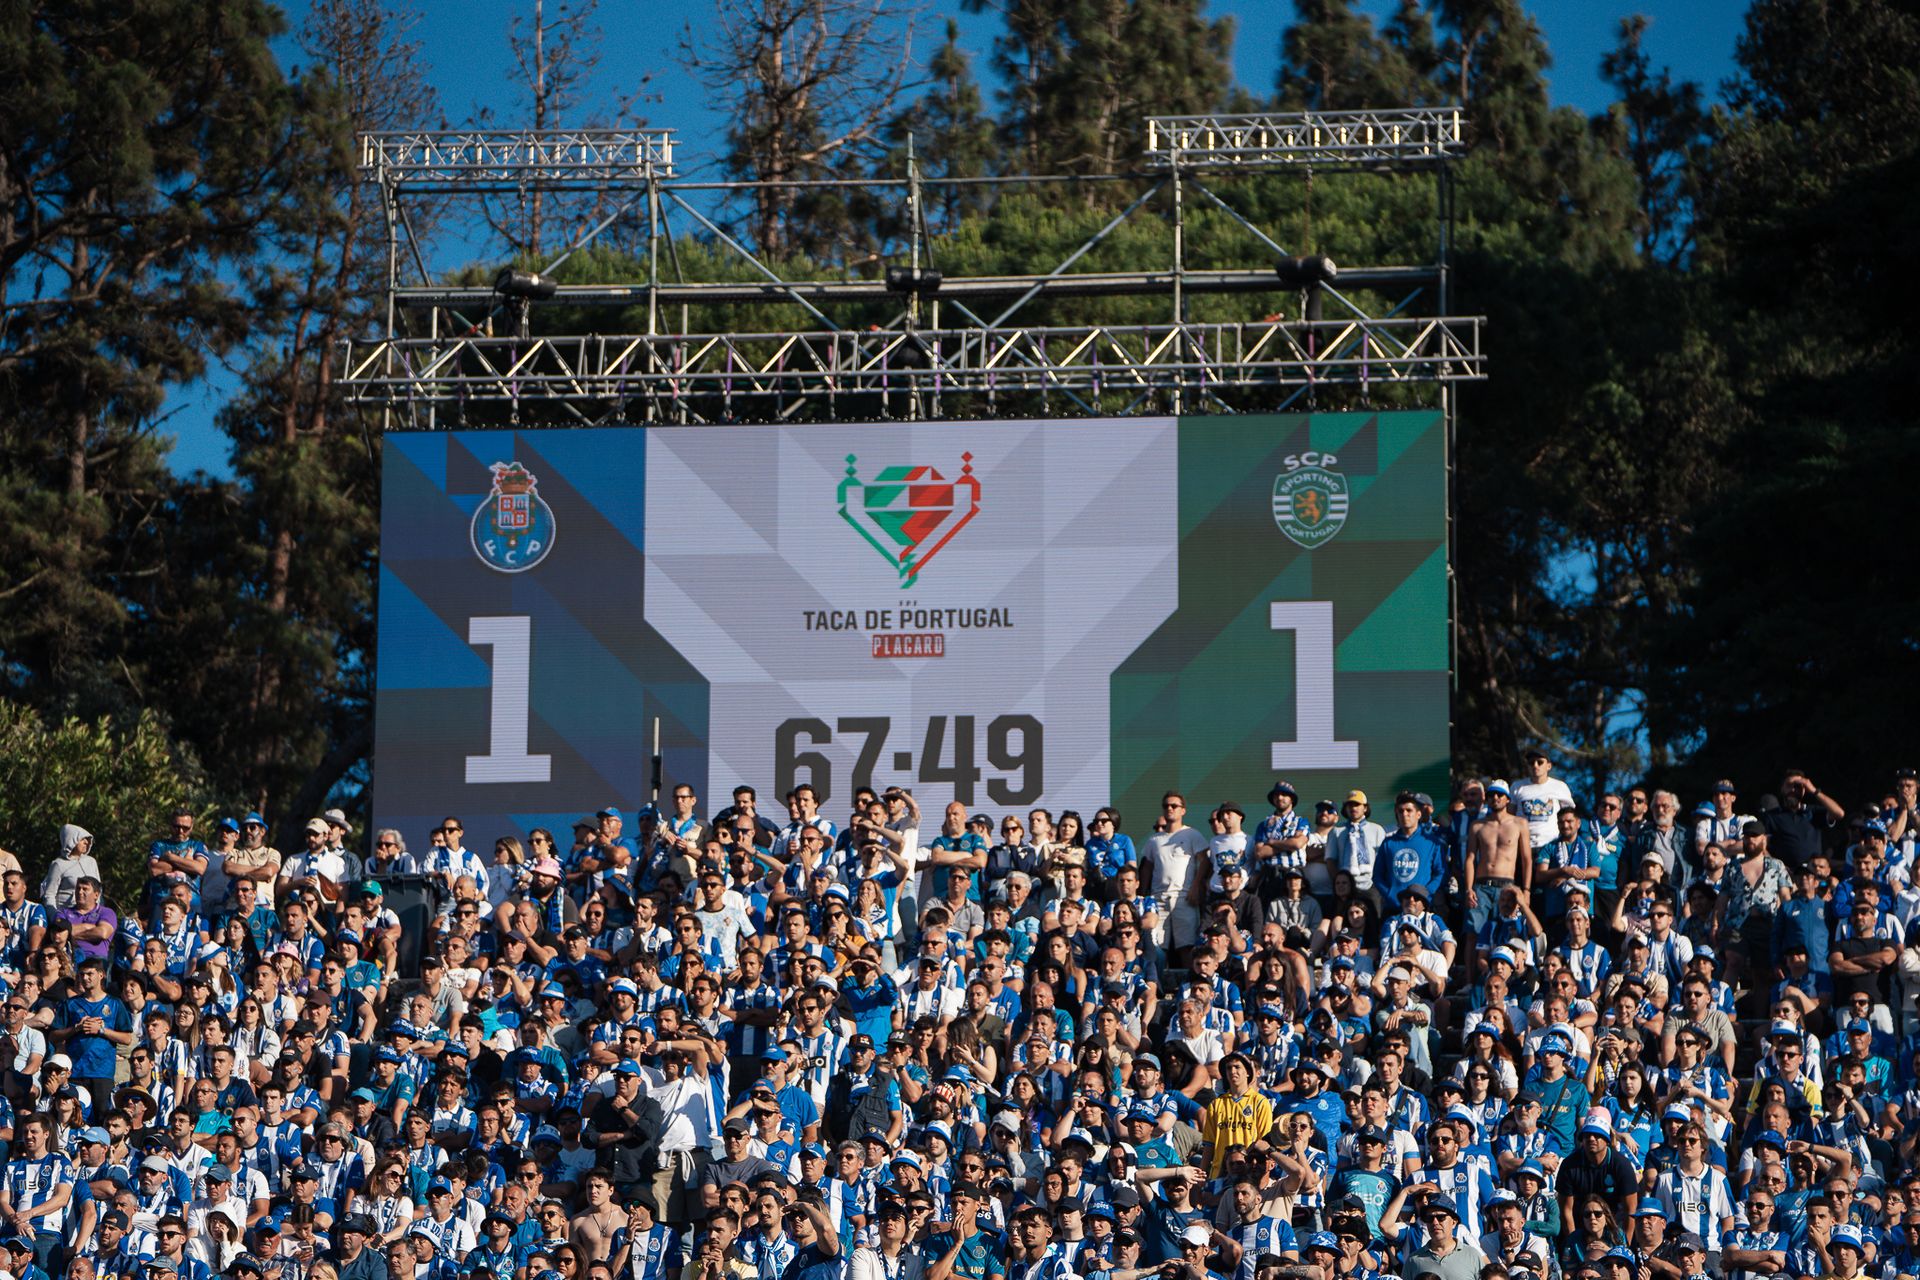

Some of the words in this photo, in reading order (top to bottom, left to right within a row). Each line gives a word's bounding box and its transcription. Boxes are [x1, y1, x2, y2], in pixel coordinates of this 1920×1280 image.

[1283, 451, 1337, 471] SCP
[1281, 473, 1340, 493] SPORTING
[1284, 523, 1338, 539] PORTUGAL
[865, 610, 892, 630] DE
[900, 608, 1014, 630] PORTUGAL
[873, 635, 944, 656] PLACARD
[1270, 601, 1359, 769] 1
[465, 616, 551, 784] 1
